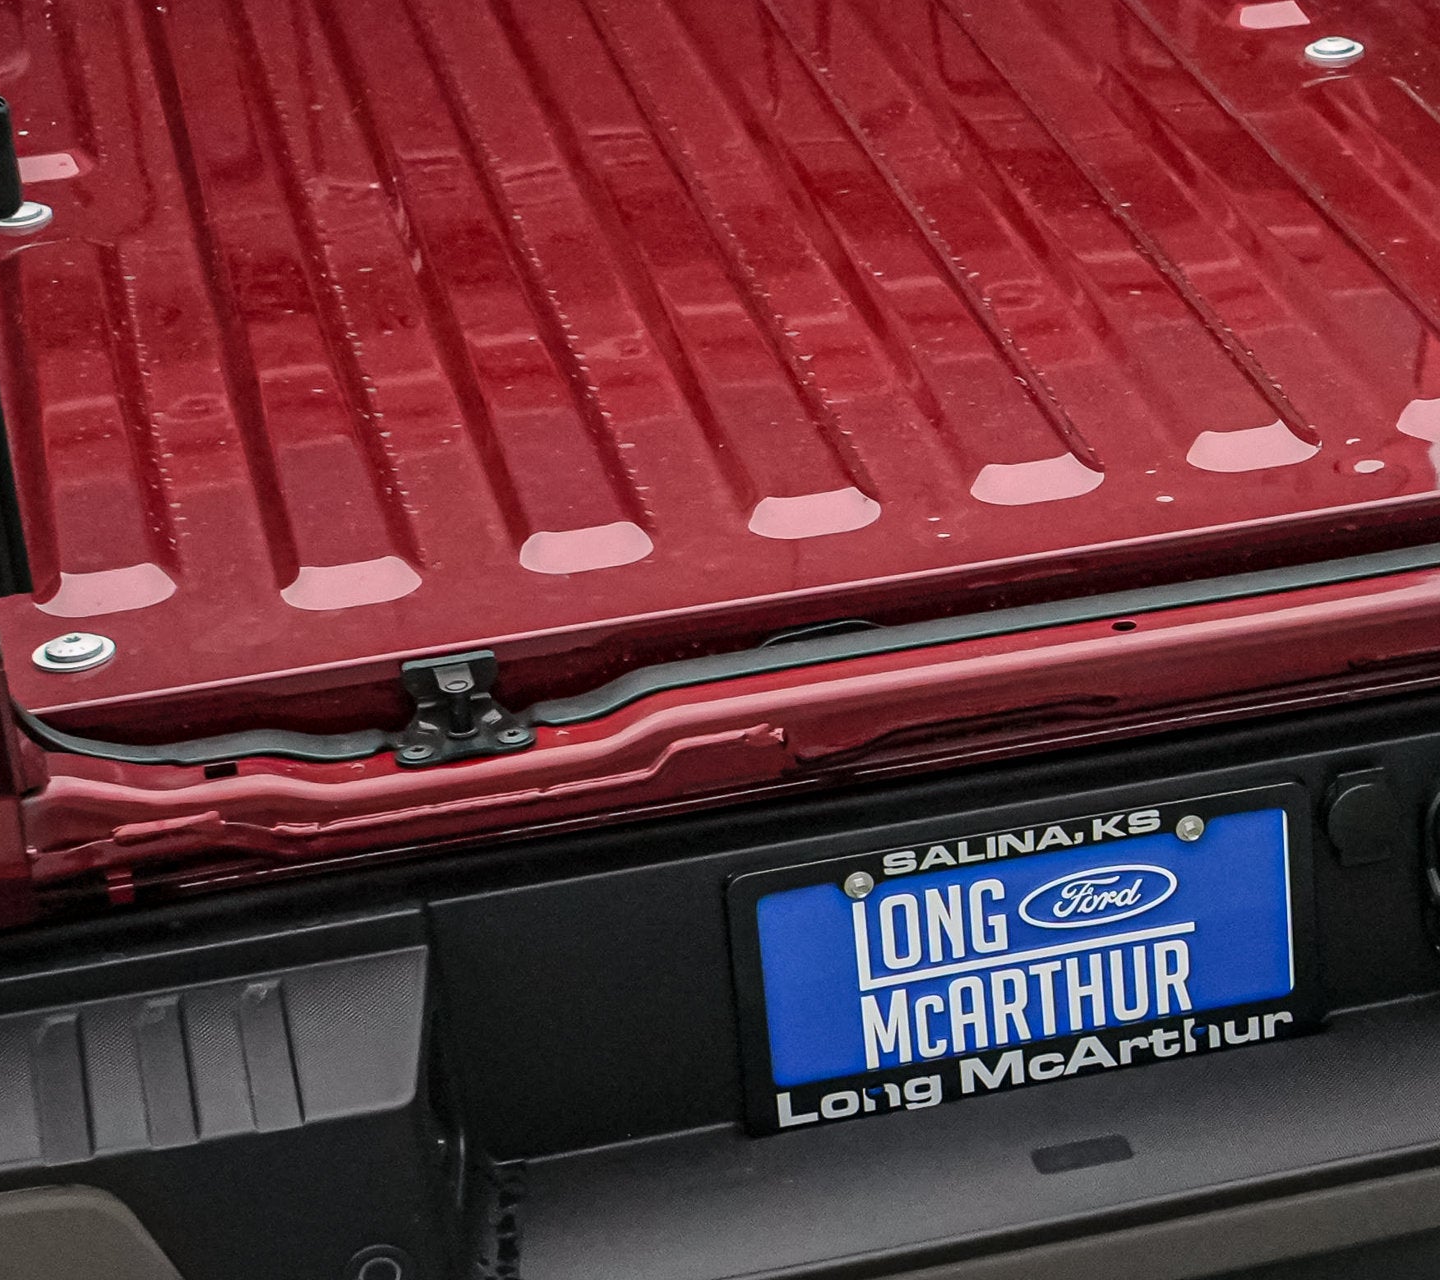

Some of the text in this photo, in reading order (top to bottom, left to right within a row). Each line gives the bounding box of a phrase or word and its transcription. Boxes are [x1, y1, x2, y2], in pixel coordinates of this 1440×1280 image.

[1091, 809, 1162, 841] KS
[853, 875, 1144, 991] LONG Ford
[777, 1011, 1293, 1128] Long McArthur
